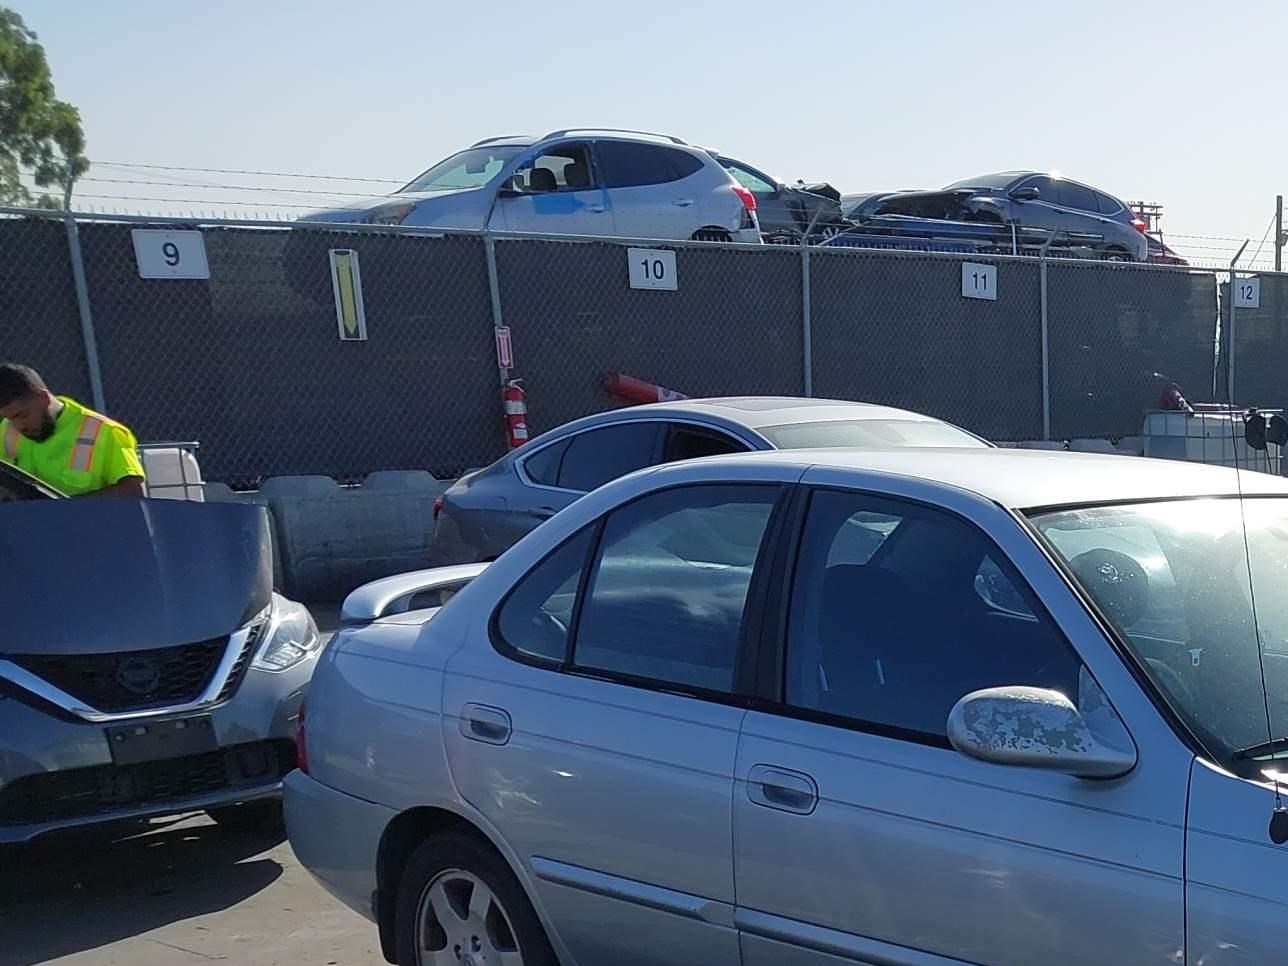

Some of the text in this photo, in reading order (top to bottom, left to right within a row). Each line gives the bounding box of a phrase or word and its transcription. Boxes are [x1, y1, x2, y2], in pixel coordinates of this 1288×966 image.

[162, 242, 180, 267] 9
[641, 258, 664, 280] 10
[972, 271, 987, 291] 11
[1240, 285, 1253, 300] 12
